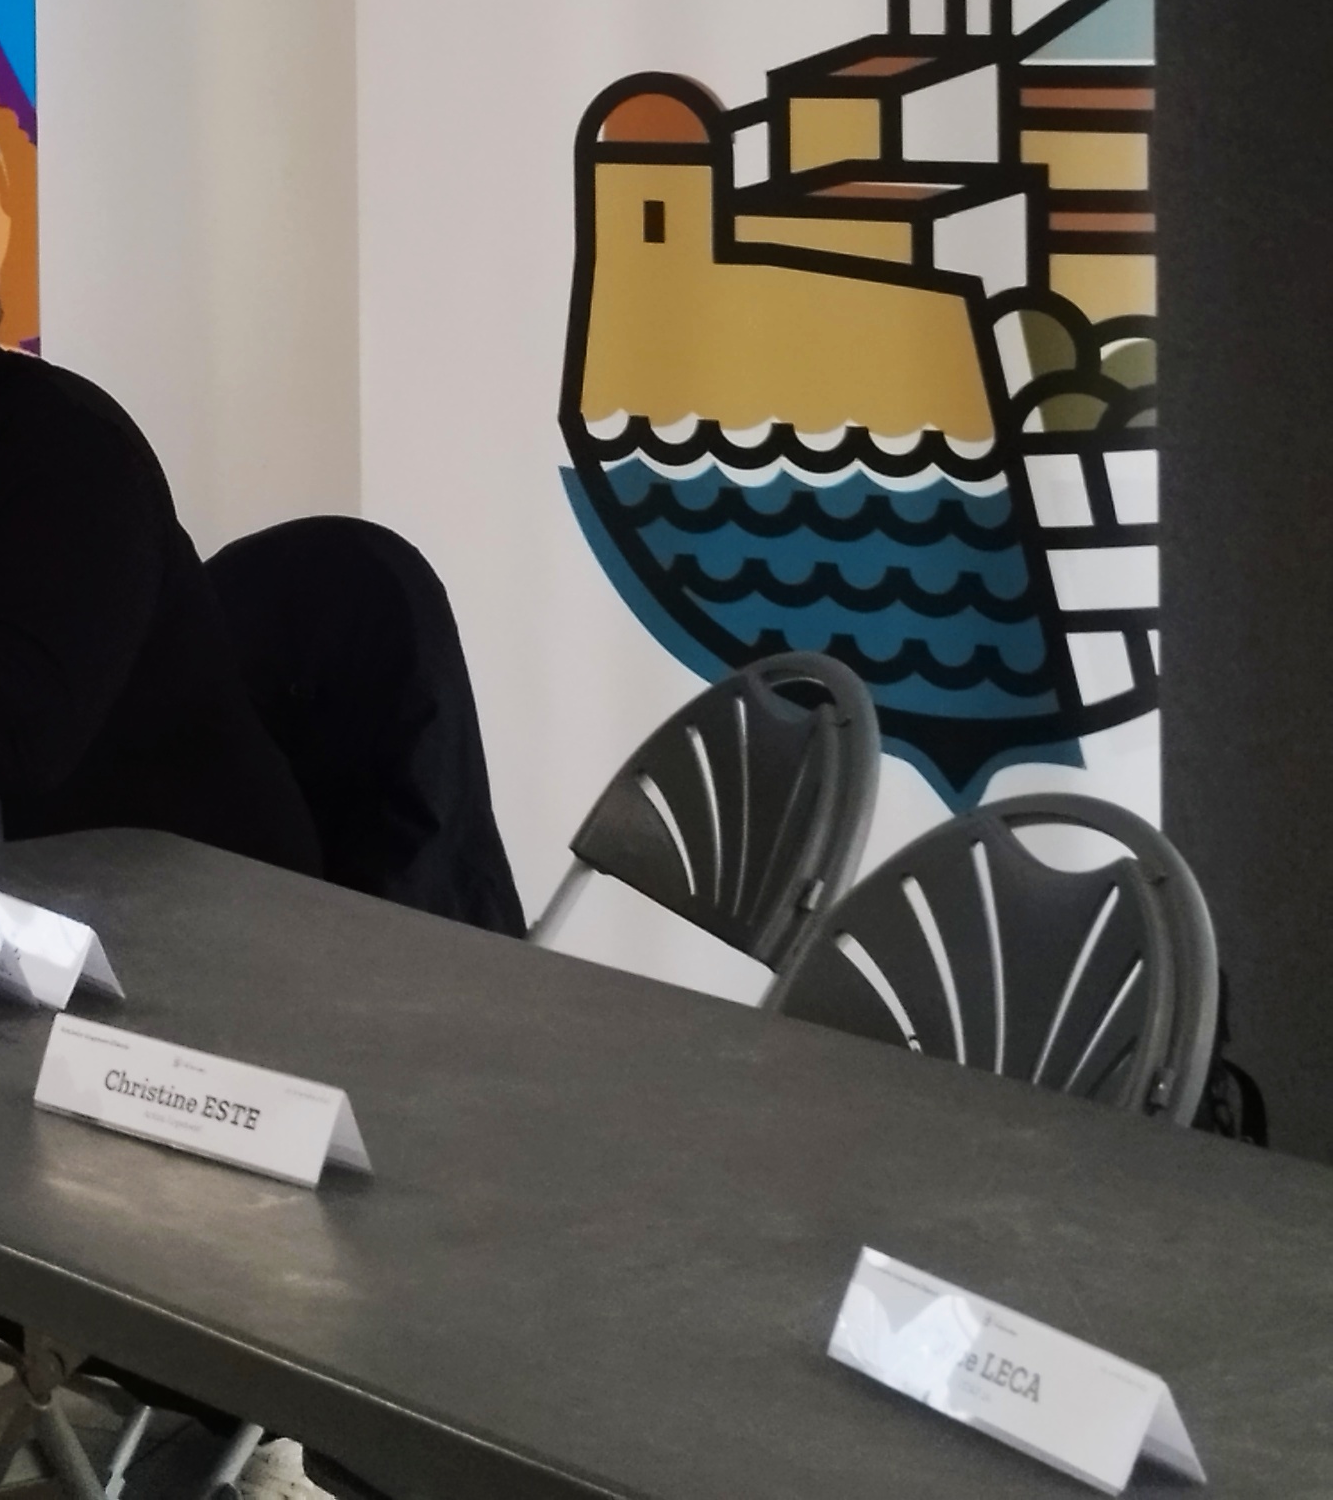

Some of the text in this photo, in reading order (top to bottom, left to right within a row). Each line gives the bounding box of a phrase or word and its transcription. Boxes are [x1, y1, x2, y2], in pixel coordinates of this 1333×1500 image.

[104, 1068, 199, 1115] Christine
[201, 1094, 262, 1131] ESTE
[979, 1352, 1041, 1404] LECA
